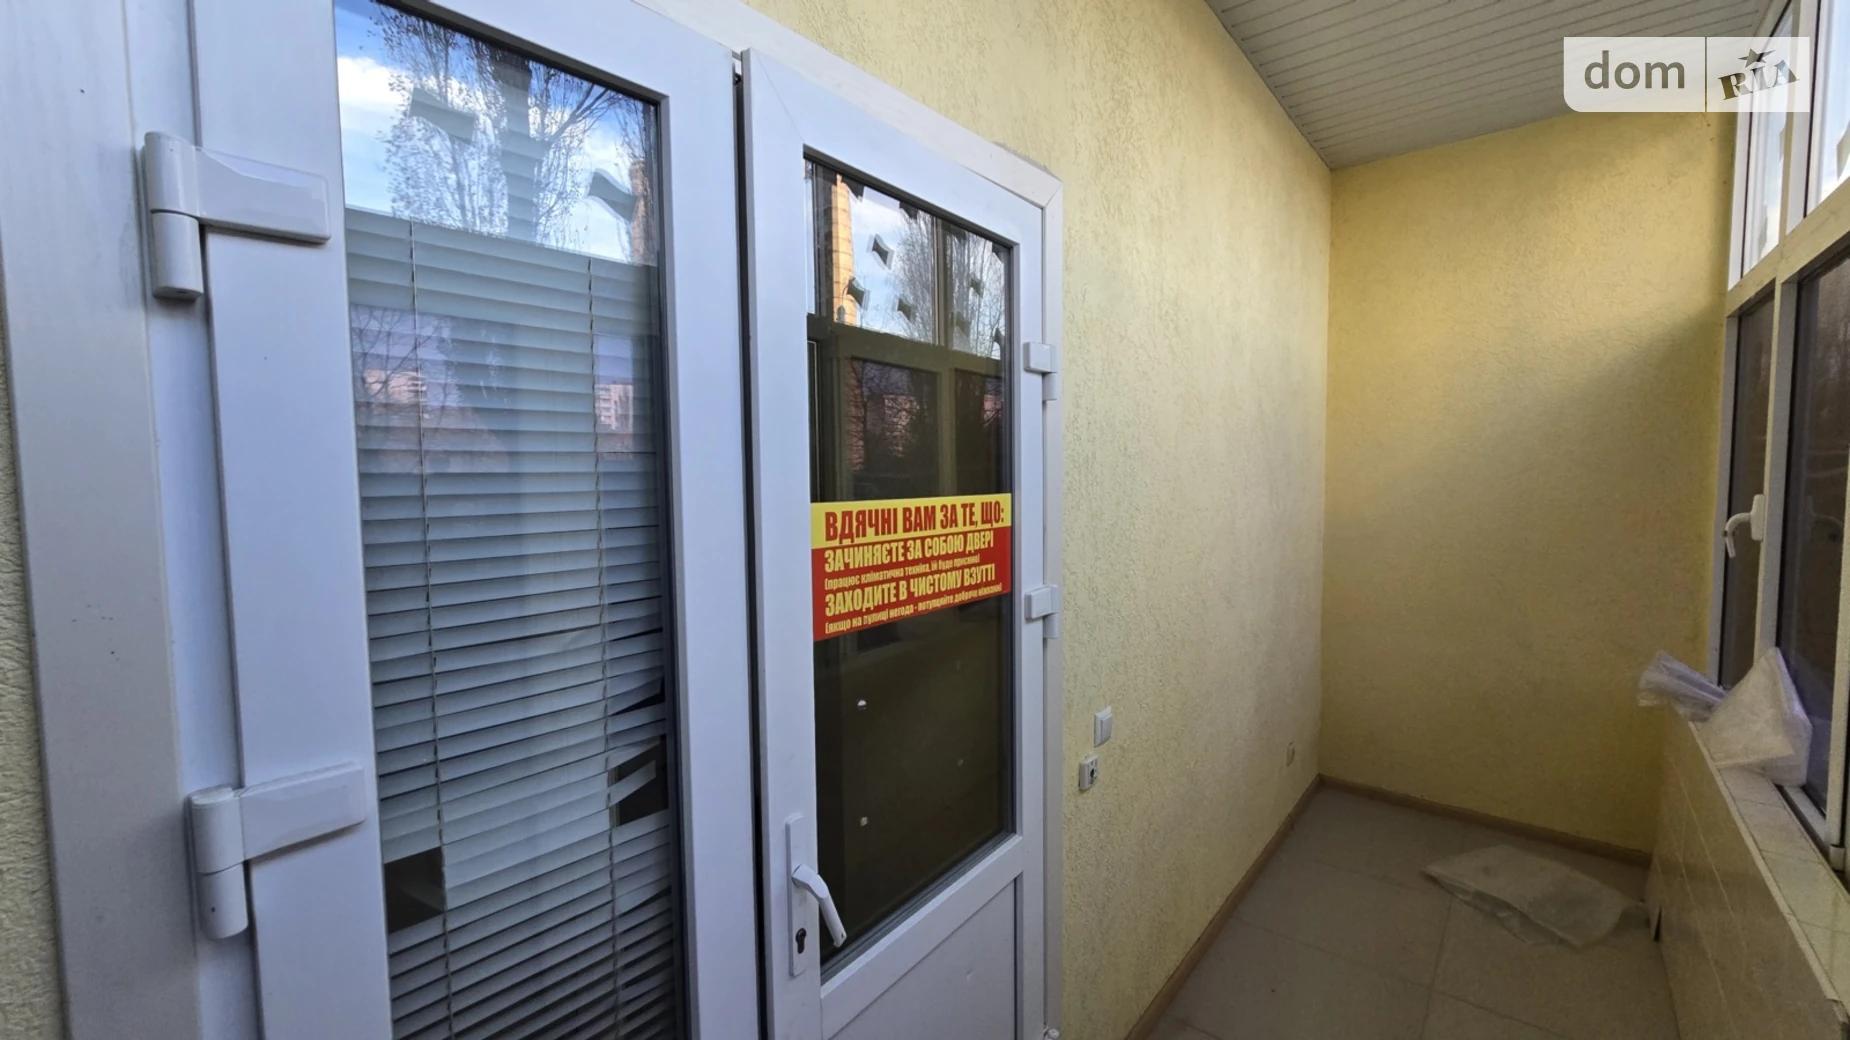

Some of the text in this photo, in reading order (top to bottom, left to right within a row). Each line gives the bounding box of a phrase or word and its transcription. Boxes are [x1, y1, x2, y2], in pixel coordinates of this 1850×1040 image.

[825, 500, 1004, 544] ВДЯЧНІ ВАМ ЗА ТЕ, ЩО:
[825, 530, 994, 572] ЗАЧИНЯЄТЕ ЗА СОБОЮ ДВЕРІ
[825, 575, 860, 590] (працює
[825, 563, 996, 617] ЗАХОДИТЕ В ЧИСТОМУ ВЗУТТІ
[825, 619, 851, 634] (якщо
[852, 616, 862, 627] на
